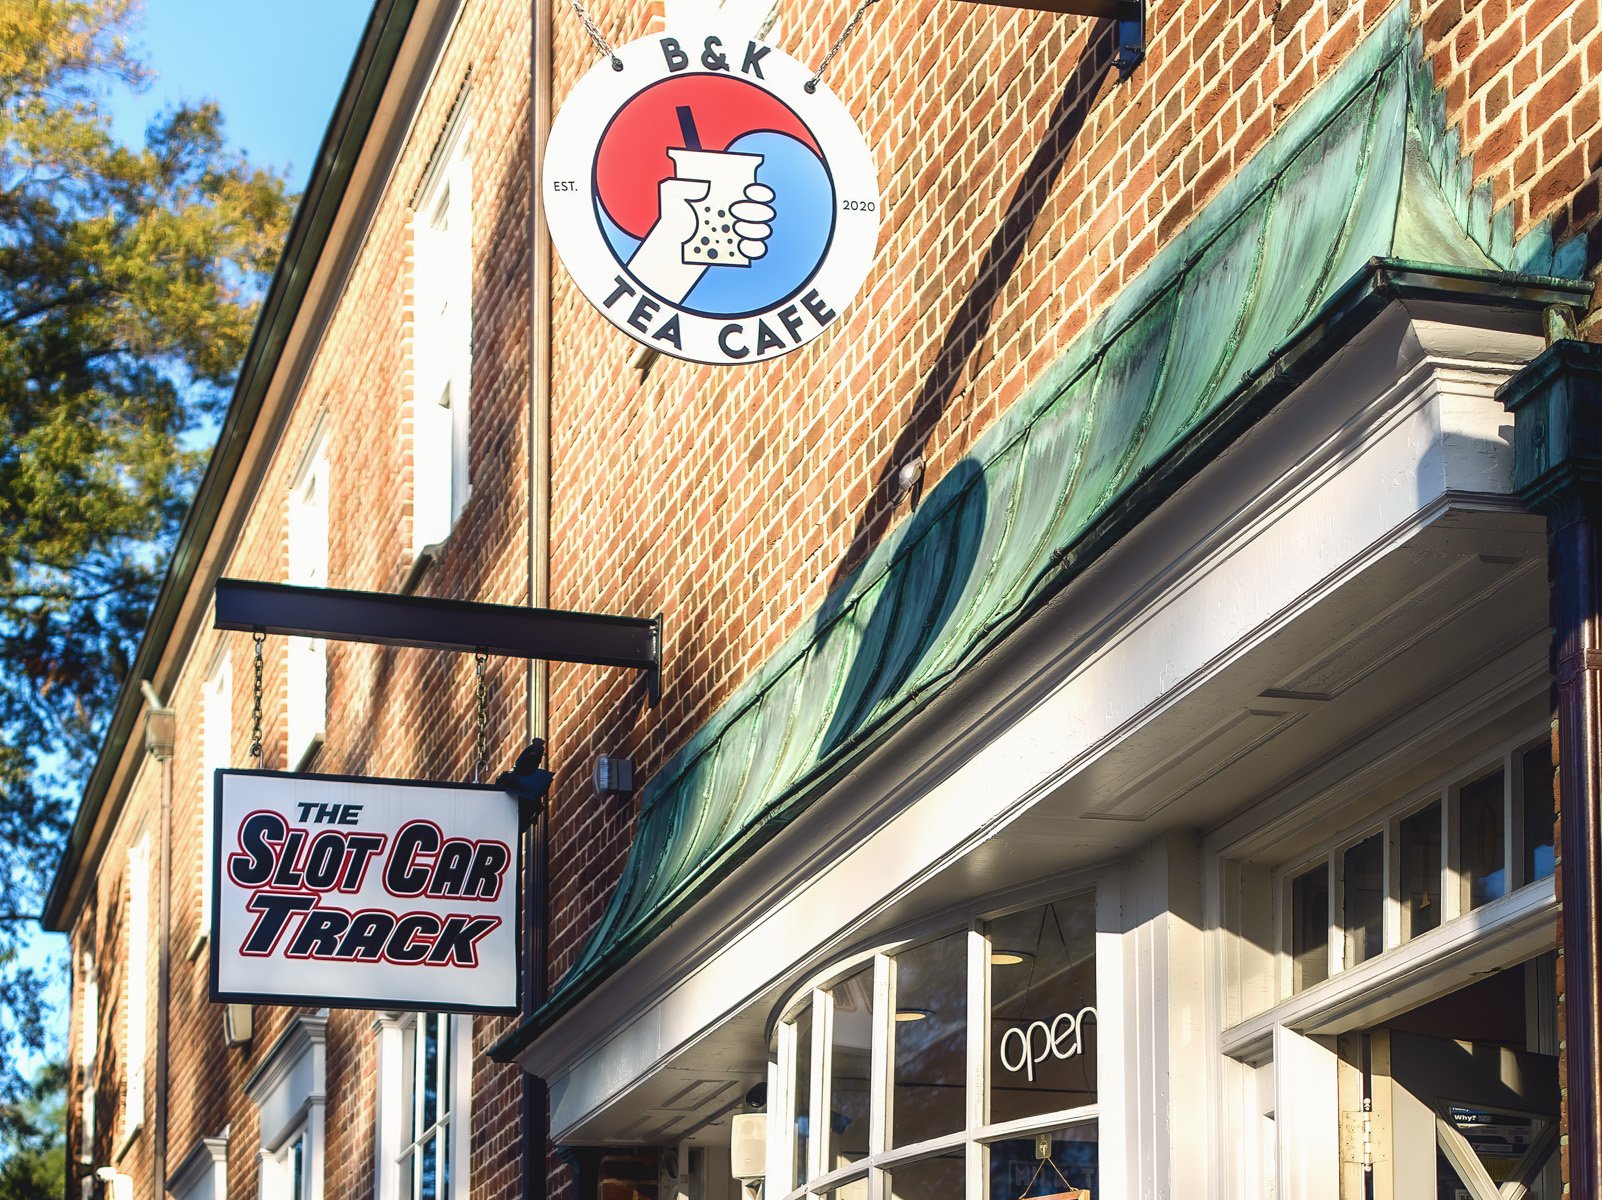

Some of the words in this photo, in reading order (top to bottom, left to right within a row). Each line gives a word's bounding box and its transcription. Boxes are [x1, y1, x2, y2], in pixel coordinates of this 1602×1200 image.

[553, 180, 578, 192] EST.
[842, 199, 876, 212] 2020
[602, 274, 683, 351] TEA
[718, 287, 837, 359] CAFE
[297, 801, 364, 826] THE
[227, 809, 388, 894] SLOT
[382, 819, 512, 902] CAR
[239, 890, 502, 969] TRACK
[1000, 1006, 1097, 1082] open
[1453, 1114, 1477, 1123] Why?
